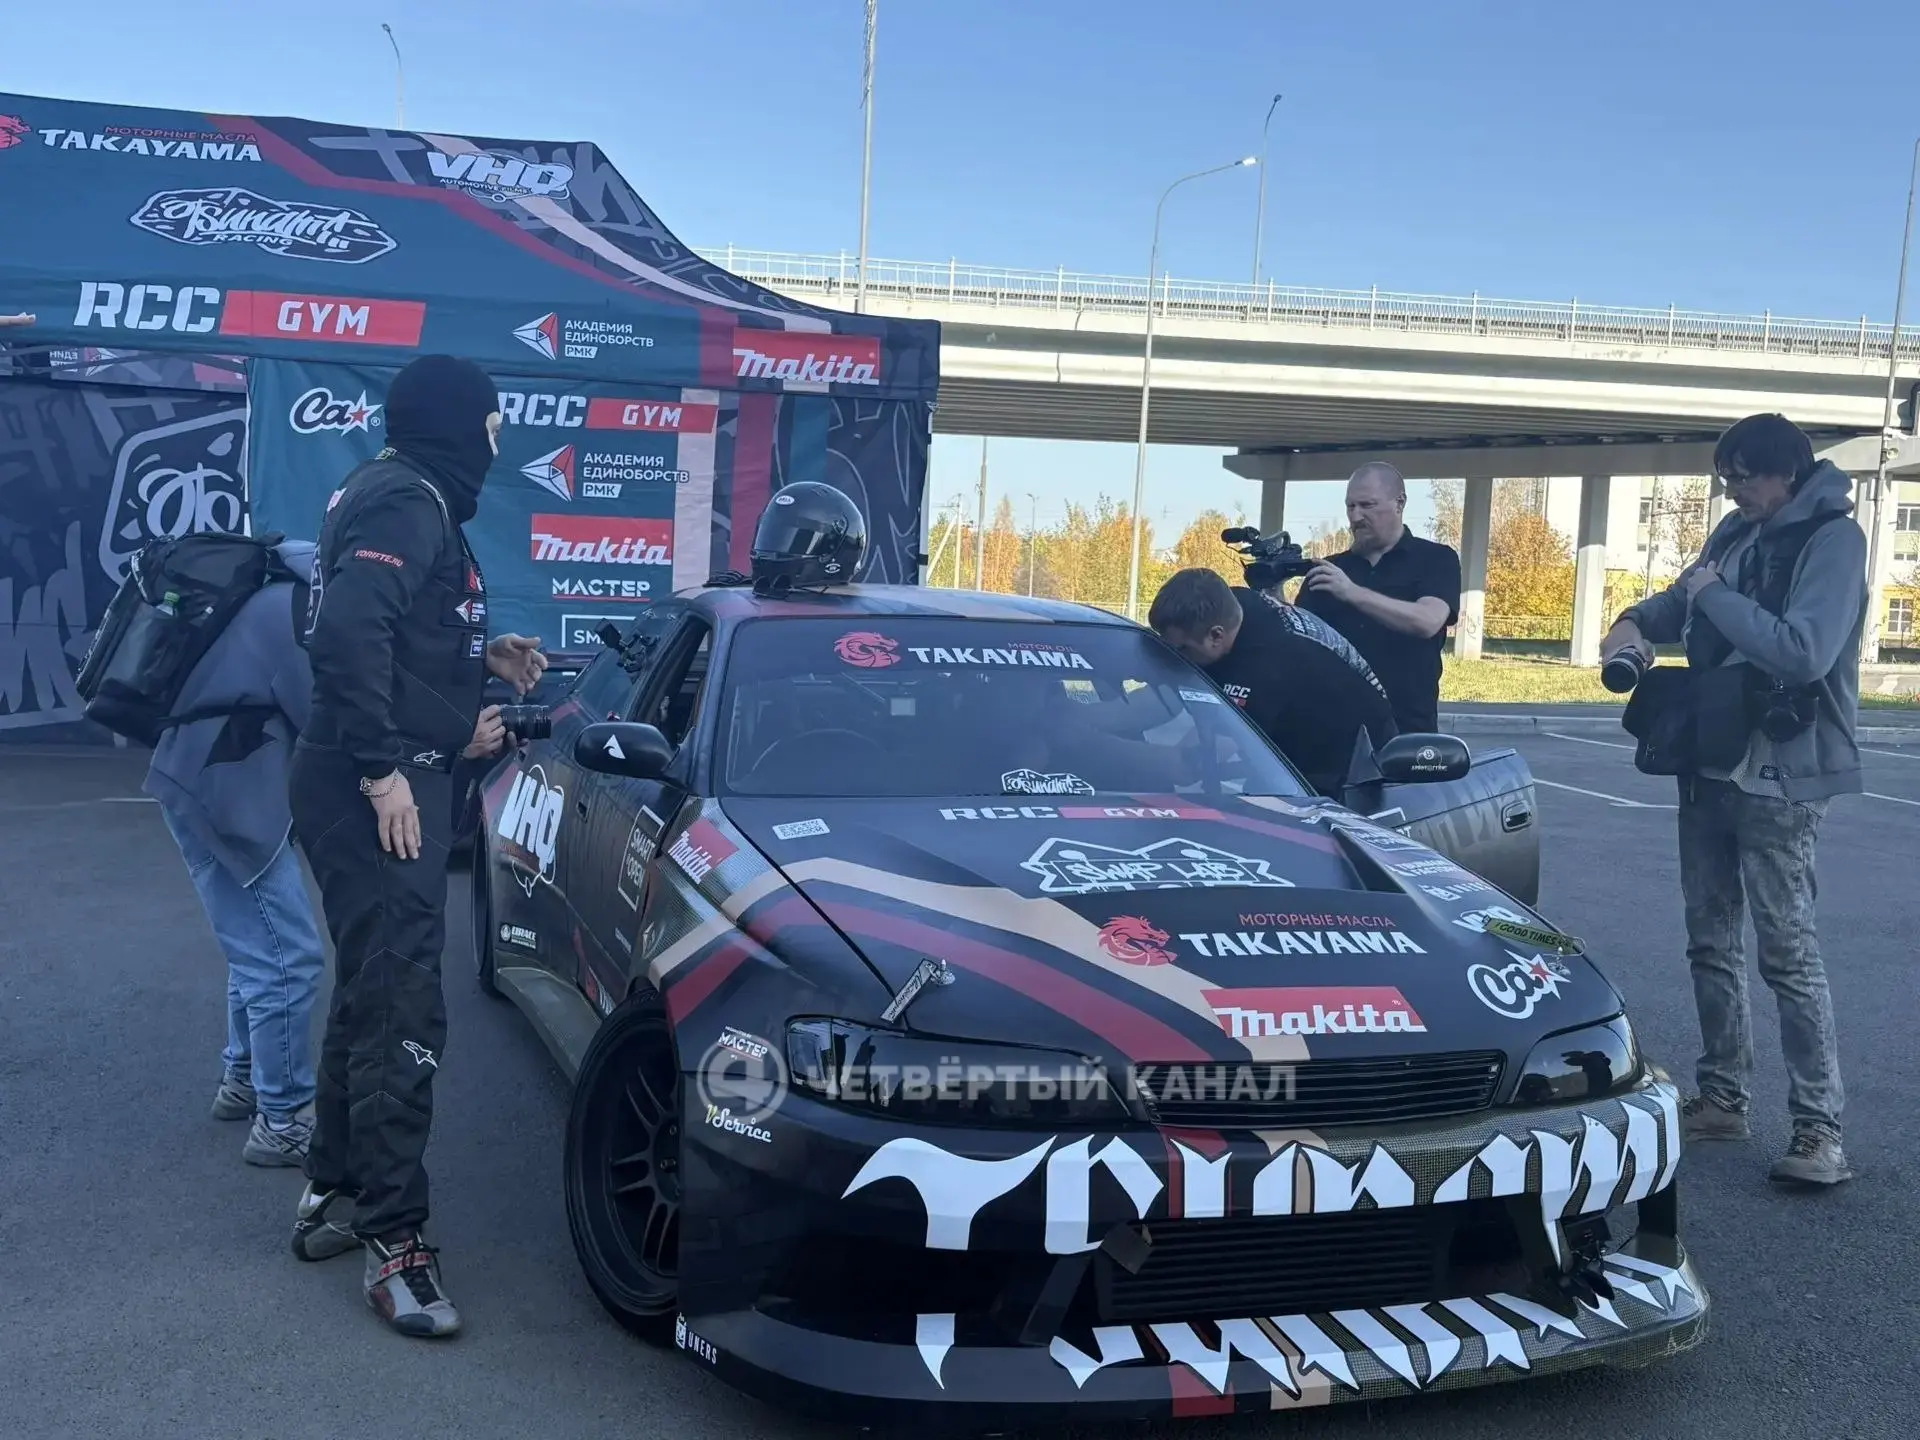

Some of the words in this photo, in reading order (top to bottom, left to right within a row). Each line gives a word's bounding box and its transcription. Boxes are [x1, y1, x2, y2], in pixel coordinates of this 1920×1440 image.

[104, 126, 197, 139] МОТОРНЫЕ
[200, 131, 257, 142] МАСЛА
[38, 129, 262, 161] TAKAYAMA
[439, 178, 498, 191] AUTOMOTIVE
[213, 234, 293, 246] RACING
[74, 281, 220, 332] RCC
[277, 301, 370, 336] GYM
[565, 320, 633, 334] АКАДЕМИЯ
[565, 332, 654, 348] ЕДИНОБОРСТВ
[566, 346, 594, 357] РМК
[497, 392, 587, 428] RCC
[622, 404, 682, 428] GYM
[583, 453, 664, 467] АКАДЕМИЯ
[583, 467, 689, 483] ЕДИНОБОРСТВ
[585, 484, 615, 497] РМК
[552, 577, 650, 598] МАСТЕР
[908, 647, 1094, 670] TAKAYAMA
[938, 806, 1059, 820] RCC
[1102, 807, 1181, 819] GYM
[631, 827, 656, 863] SMART
[1065, 862, 1163, 882] SWAP
[1167, 862, 1244, 882] LAB
[1239, 913, 1333, 927] МОТОРНЫЕ
[1337, 914, 1396, 928] МАСЛА
[1179, 931, 1427, 956] TAKAYAMA
[718, 1031, 768, 1058] МАСТЕР
